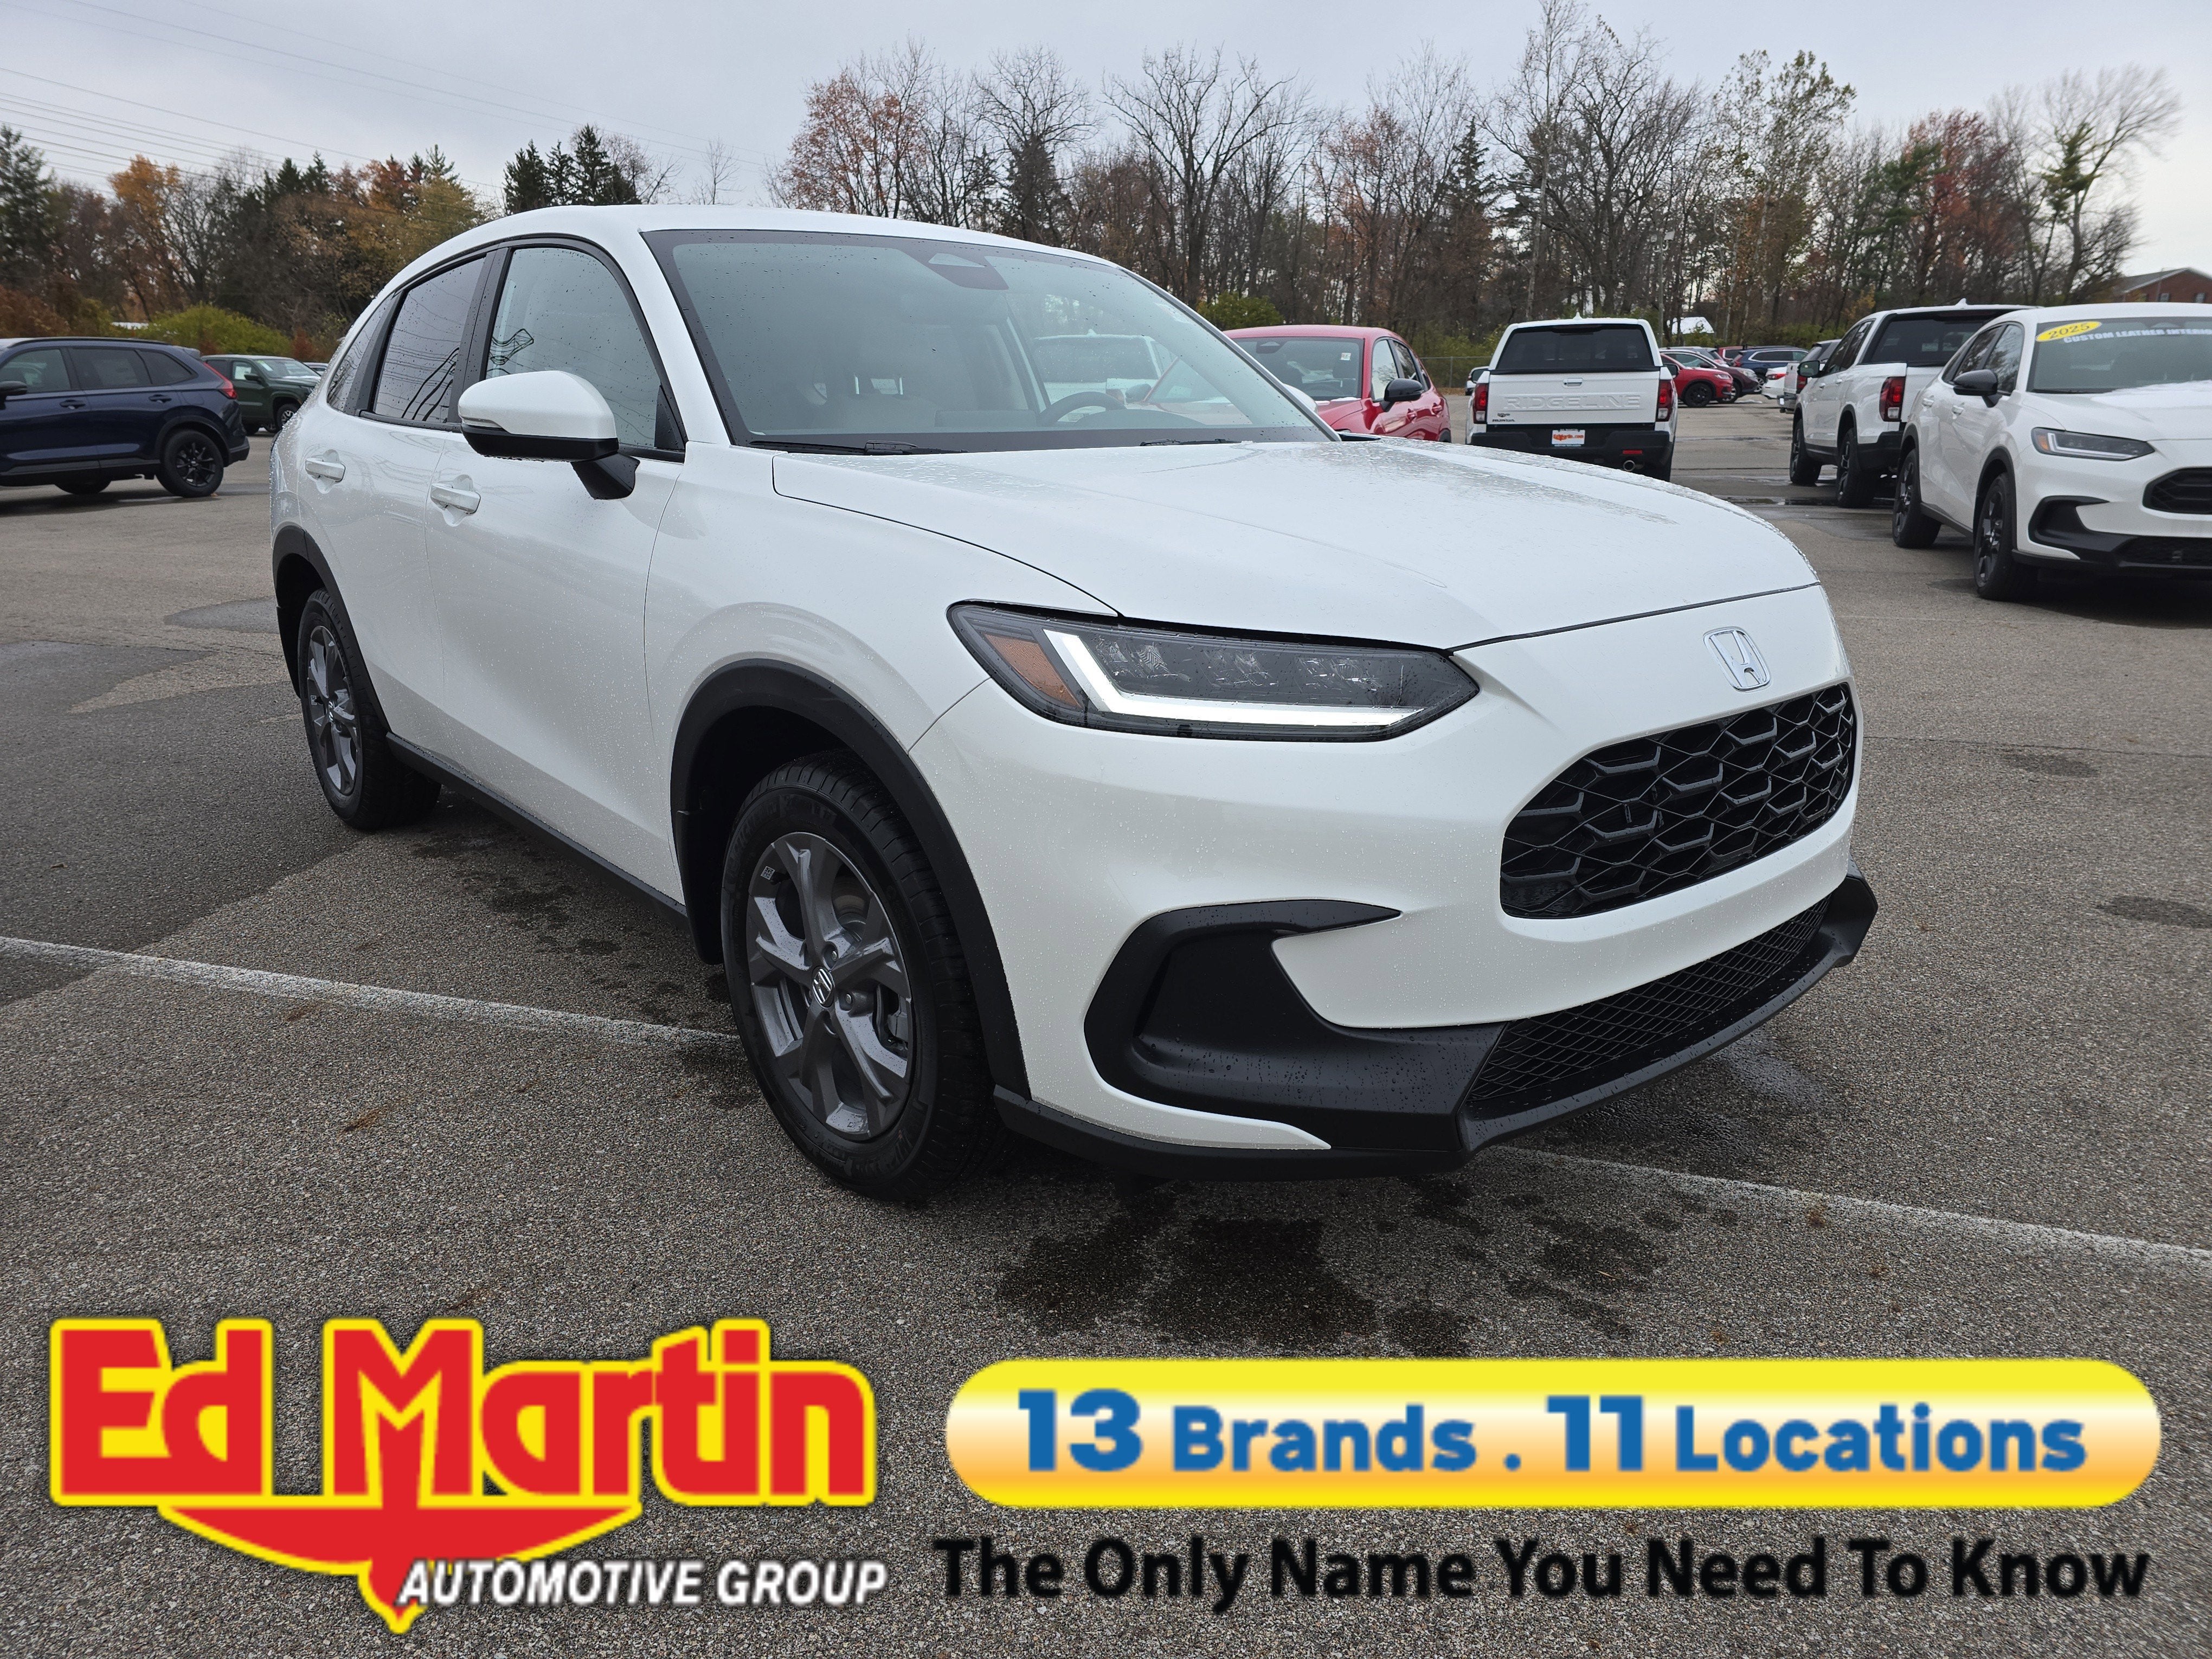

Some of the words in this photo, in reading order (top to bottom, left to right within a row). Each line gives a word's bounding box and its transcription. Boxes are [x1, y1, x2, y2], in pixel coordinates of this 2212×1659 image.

[2048, 324, 2089, 338] 2025
[2063, 332, 2114, 343] CUSTOM
[2115, 329, 2165, 338] LEATHER
[1503, 395, 1641, 410] RIDGELINE
